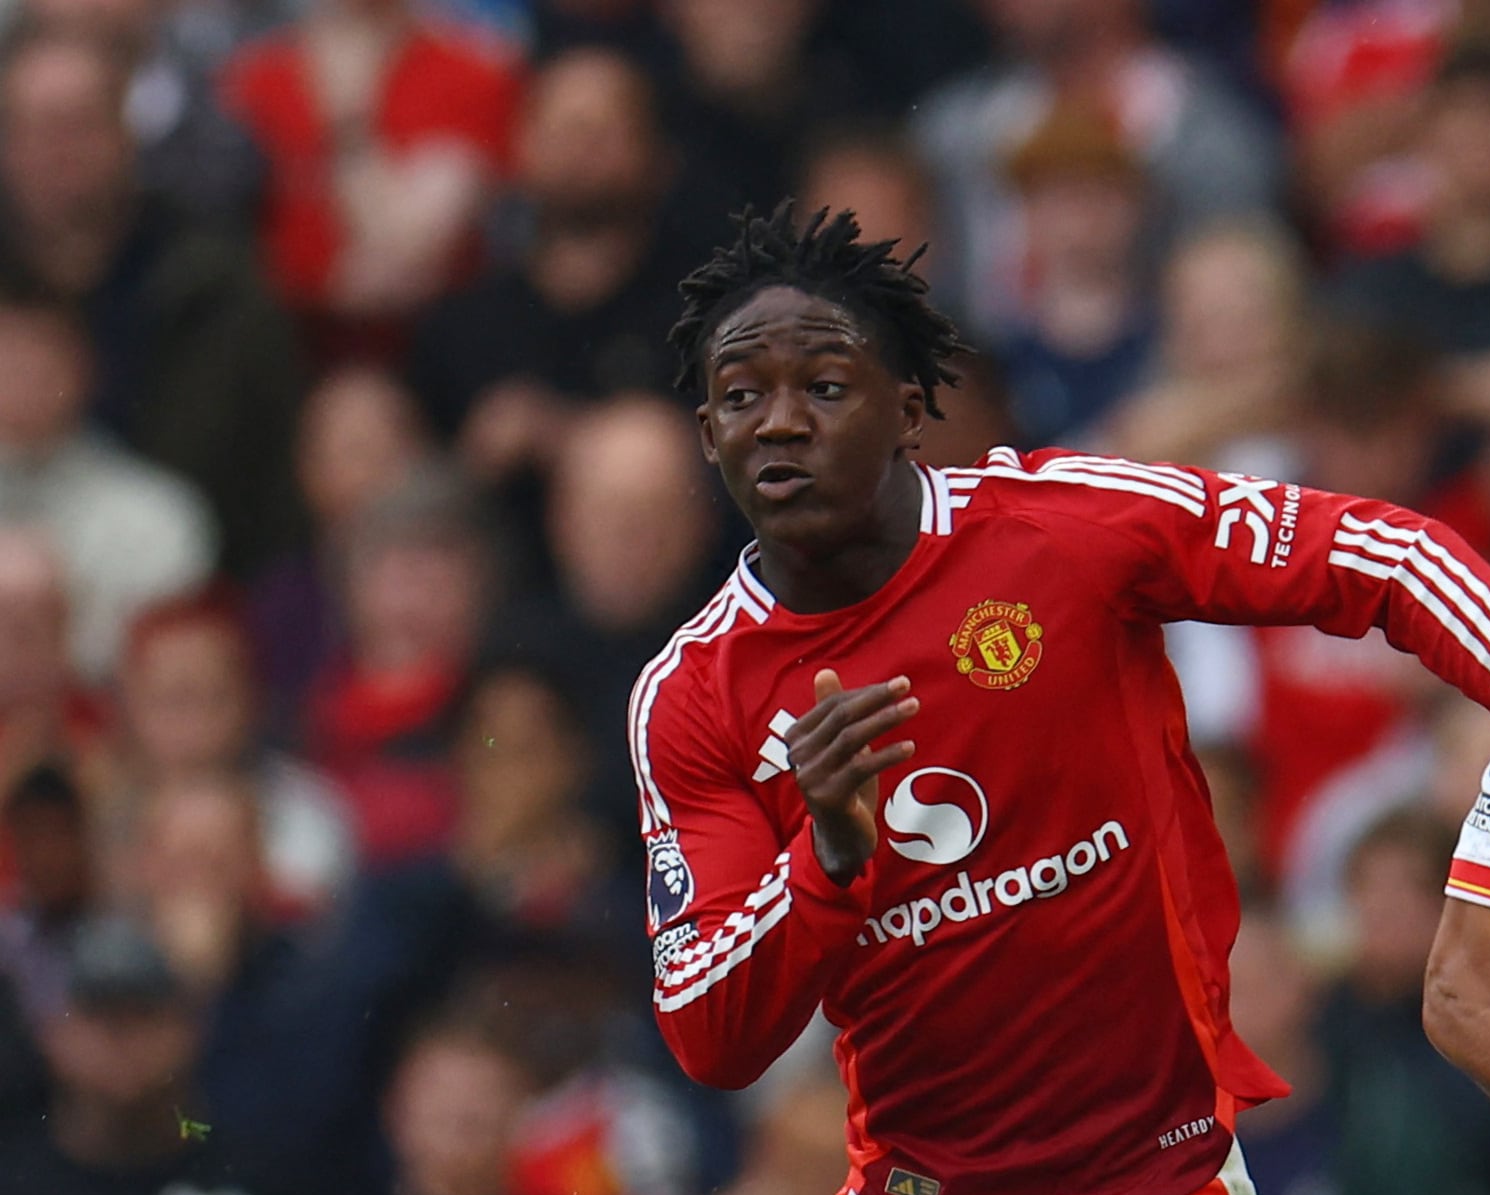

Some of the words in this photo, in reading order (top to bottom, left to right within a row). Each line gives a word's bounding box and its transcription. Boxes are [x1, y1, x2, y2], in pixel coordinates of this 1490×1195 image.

[958, 605, 1026, 651] MANCHESTER
[987, 656, 1035, 686] UNITED
[856, 820, 1130, 947] napdragon
